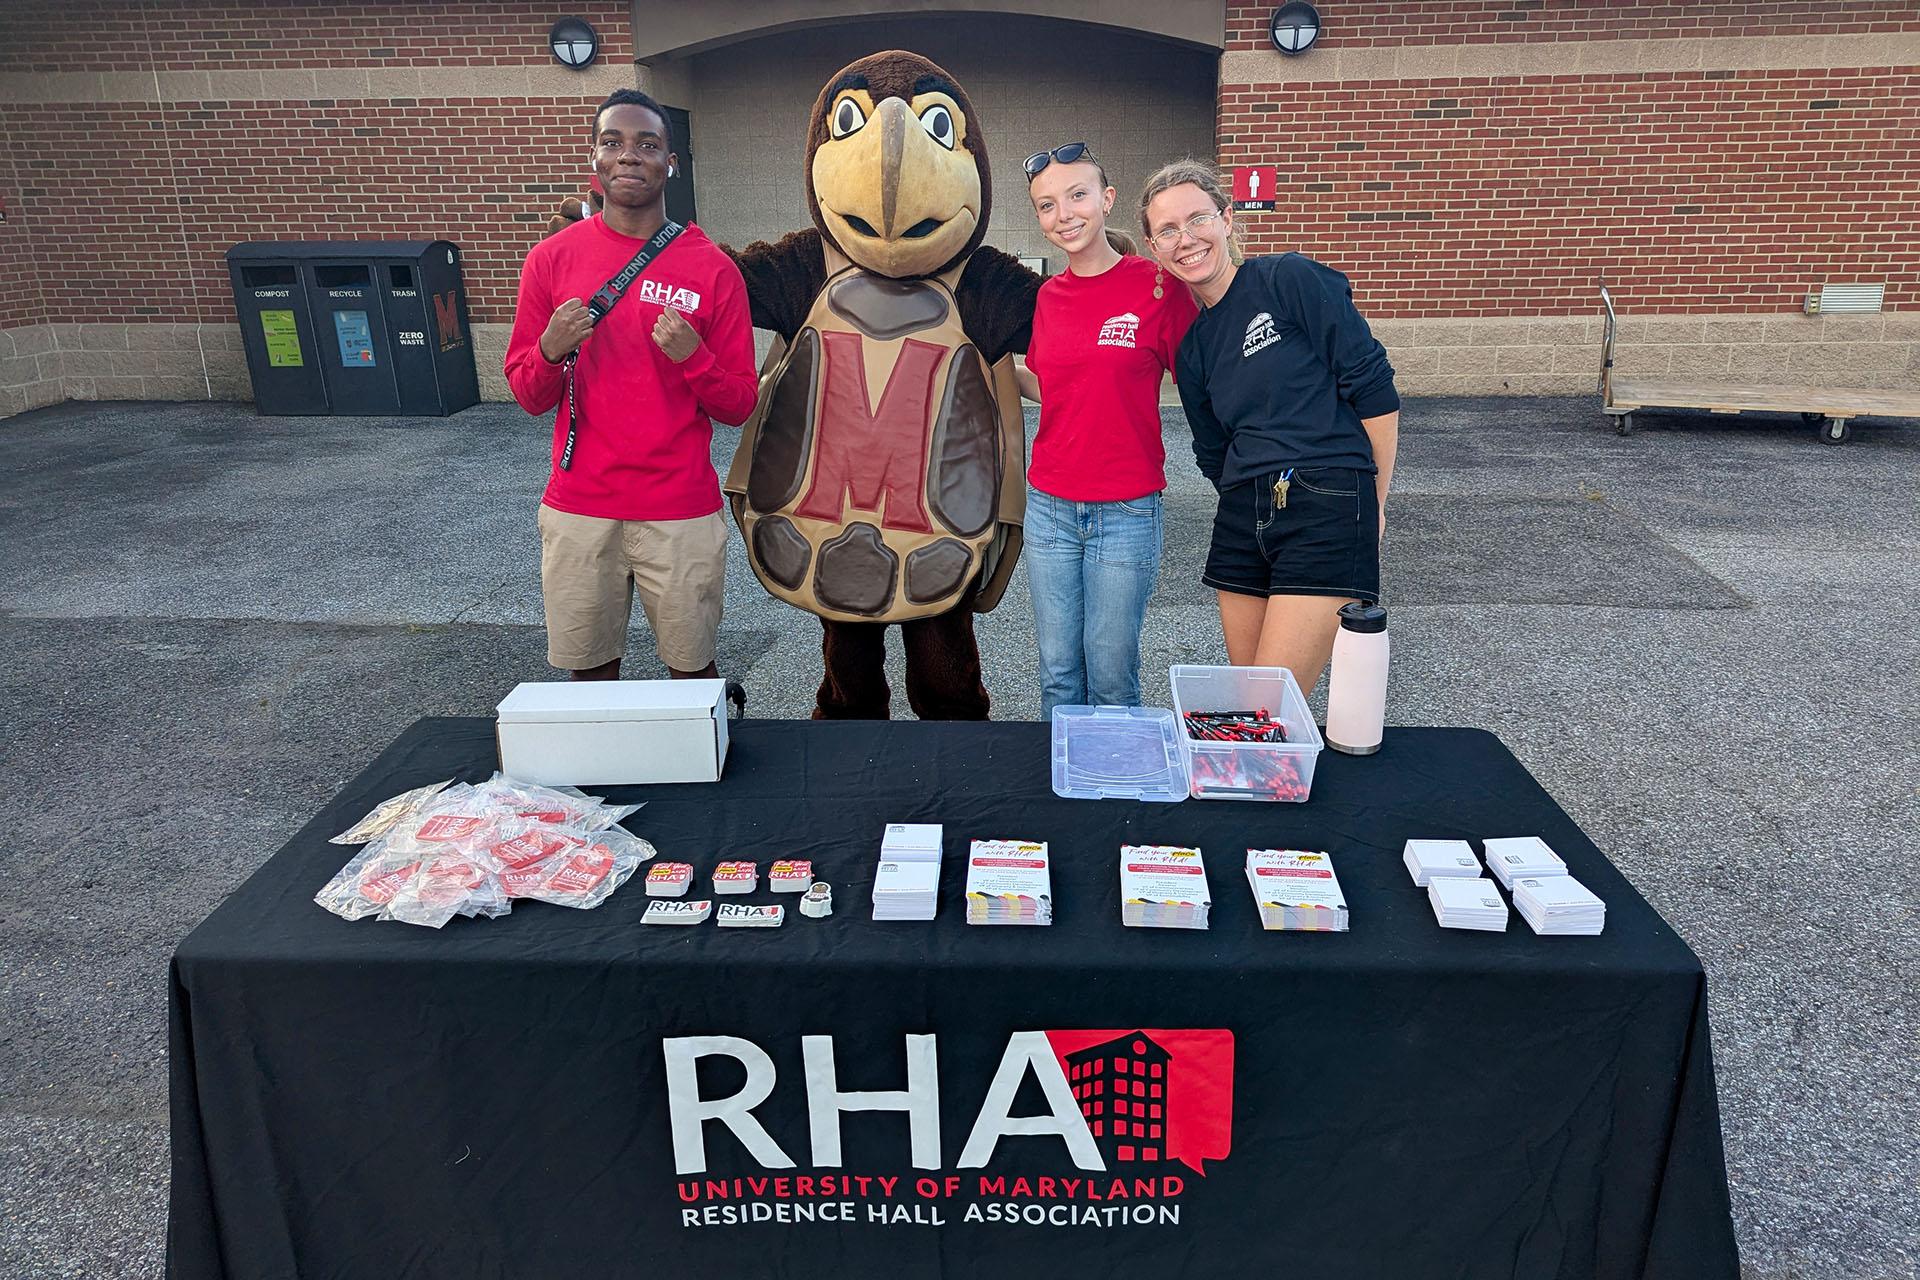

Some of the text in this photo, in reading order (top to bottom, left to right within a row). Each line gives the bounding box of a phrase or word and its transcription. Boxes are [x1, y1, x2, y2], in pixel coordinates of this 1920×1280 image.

[1245, 201, 1263, 209] MEN
[611, 252, 651, 291] UNDER
[254, 290, 290, 298] COMPOST
[640, 280, 687, 305] RHA
[433, 291, 463, 345] M
[398, 331, 424, 339] ZERO
[1099, 328, 1136, 341] RHA
[1097, 338, 1136, 349] association
[1243, 334, 1282, 358] association
[793, 330, 951, 535] M
[563, 868, 590, 880] RHA
[648, 873, 677, 881] RHA
[714, 872, 744, 880] RHA
[650, 901, 694, 912] RHA
[720, 905, 766, 916] RHA
[663, 1030, 1106, 1174] RHA
[678, 1175, 1184, 1202] UNIVERSITY OF MARYLAND
[681, 1202, 1180, 1227] RESIDENCE HALL ASSOCIATION
